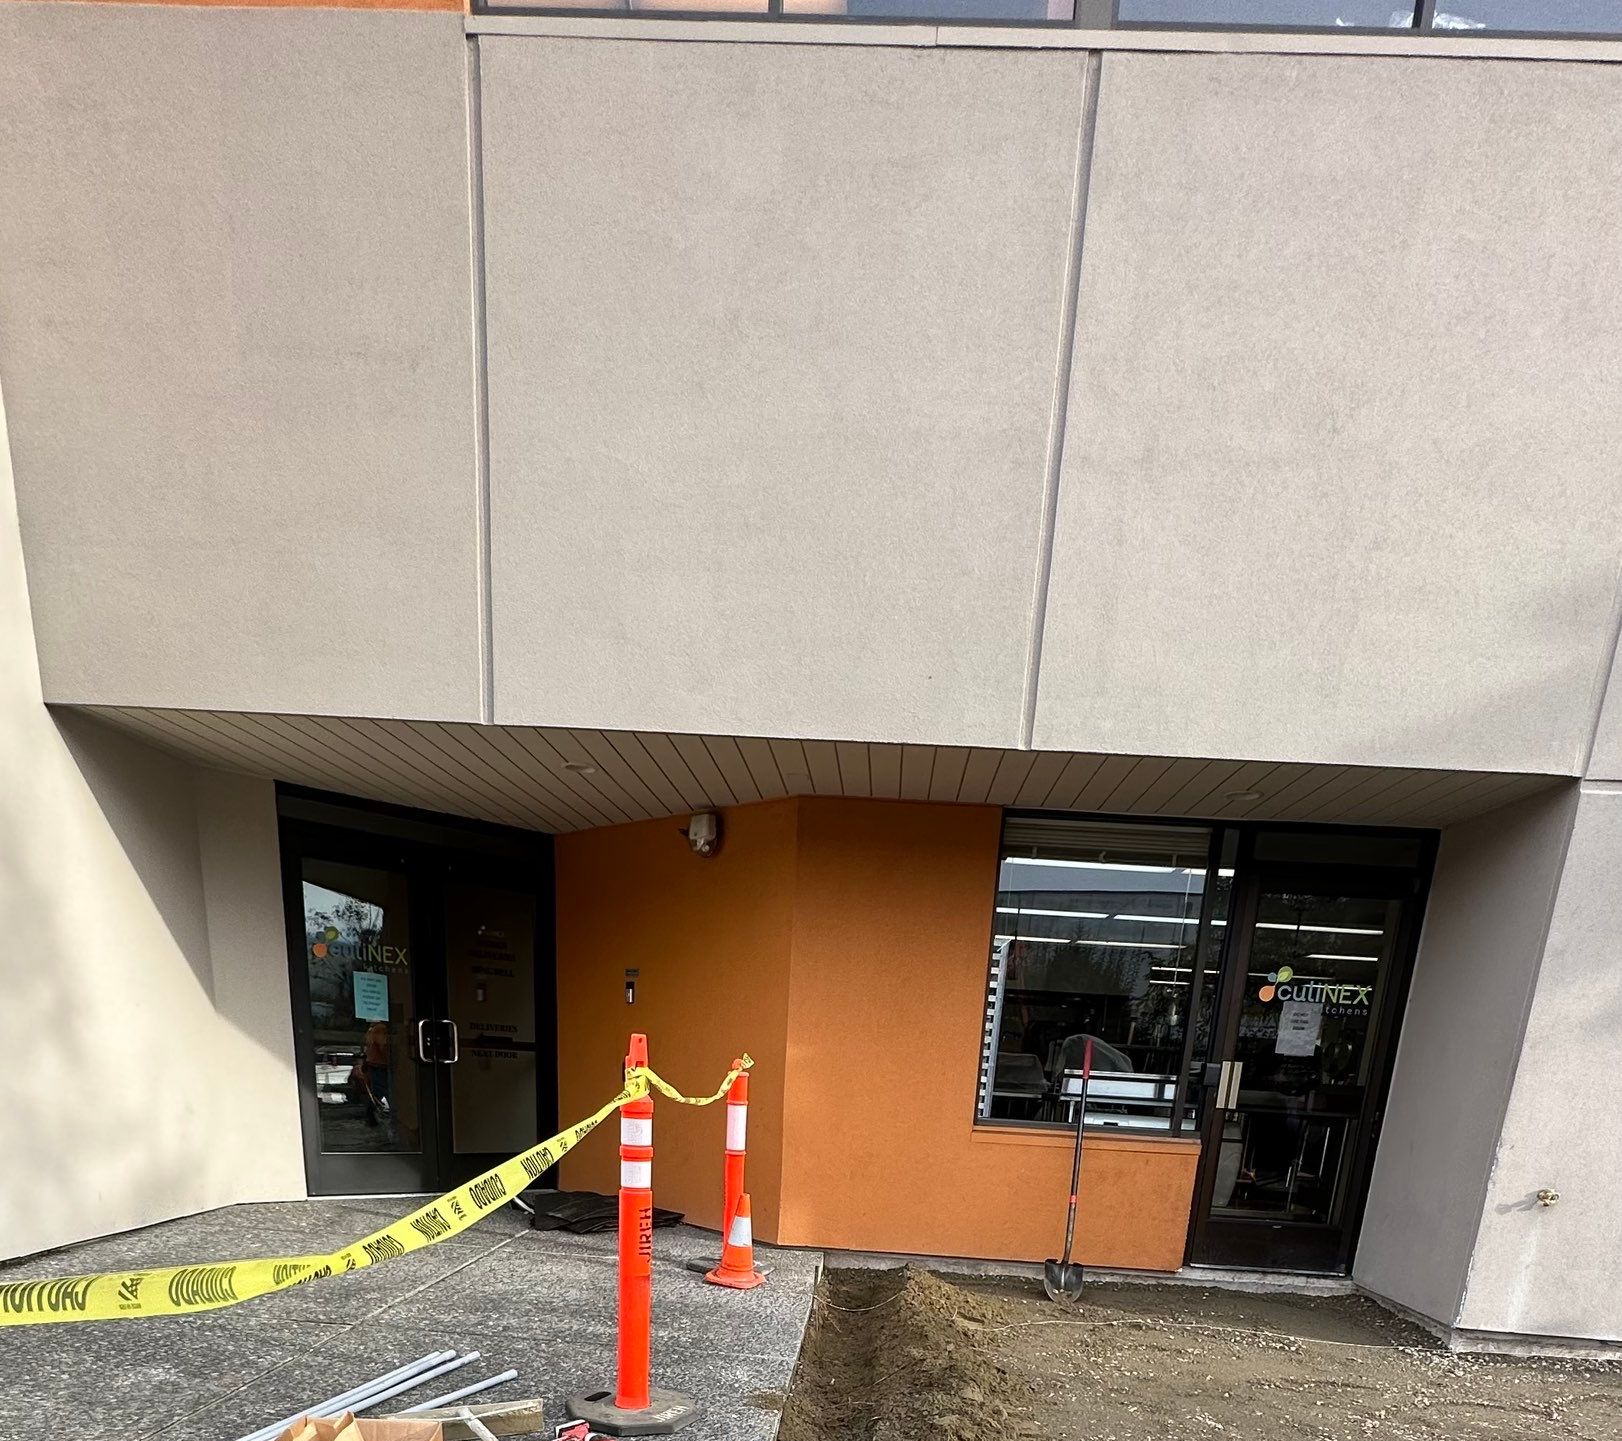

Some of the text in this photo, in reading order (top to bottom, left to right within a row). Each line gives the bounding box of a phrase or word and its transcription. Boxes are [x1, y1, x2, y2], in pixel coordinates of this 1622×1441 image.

[1322, 1005, 1368, 1017] tchens
[519, 1147, 554, 1181] CAUTION
[469, 1173, 507, 1210] CUIDADO
[410, 1208, 451, 1243] CAUTION
[638, 1207, 652, 1263] JIREH
[168, 1266, 238, 1308] CUIDADO
